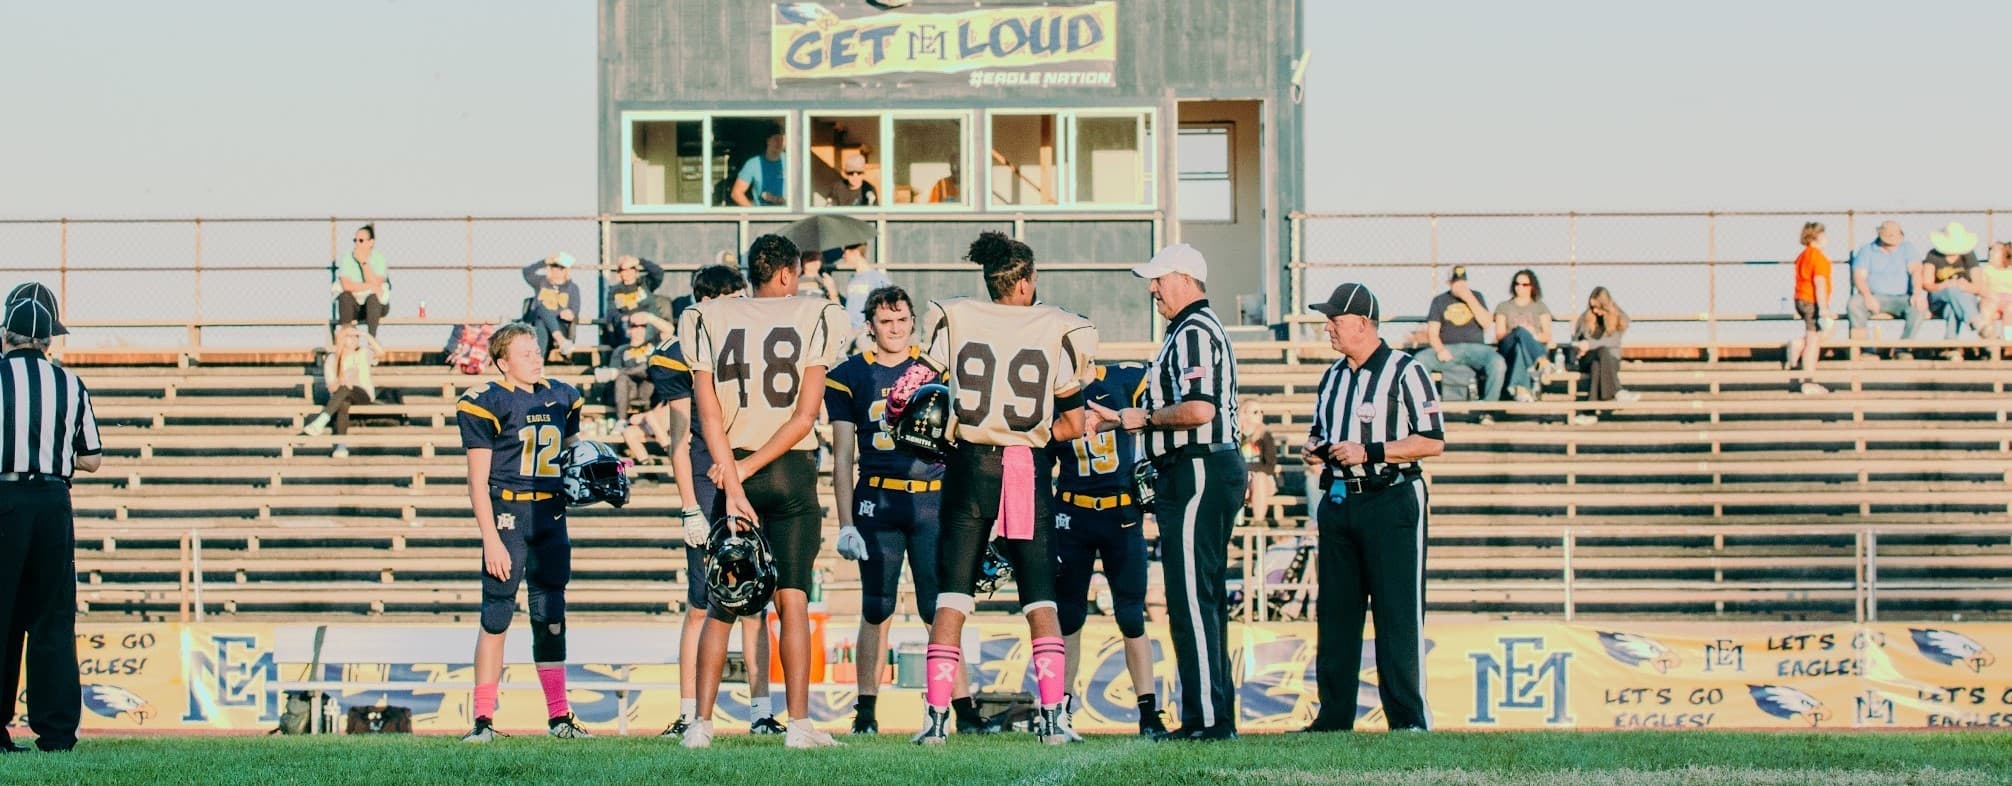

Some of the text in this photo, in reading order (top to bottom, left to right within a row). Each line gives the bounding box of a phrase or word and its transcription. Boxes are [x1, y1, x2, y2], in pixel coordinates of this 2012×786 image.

[785, 24, 901, 70] GET
[958, 14, 1105, 60] LOUD
[968, 71, 1113, 87] #EAGLE NATION
[717, 327, 803, 408] 48
[953, 341, 1050, 432] 99
[526, 414, 551, 423] EAGLES
[518, 424, 562, 477] 12
[1072, 430, 1120, 477] 19
[122, 633, 156, 649] GO
[1768, 633, 1835, 650] LET'S
[79, 657, 147, 676] GLES!
[1605, 687, 1724, 705] LET'S GO
